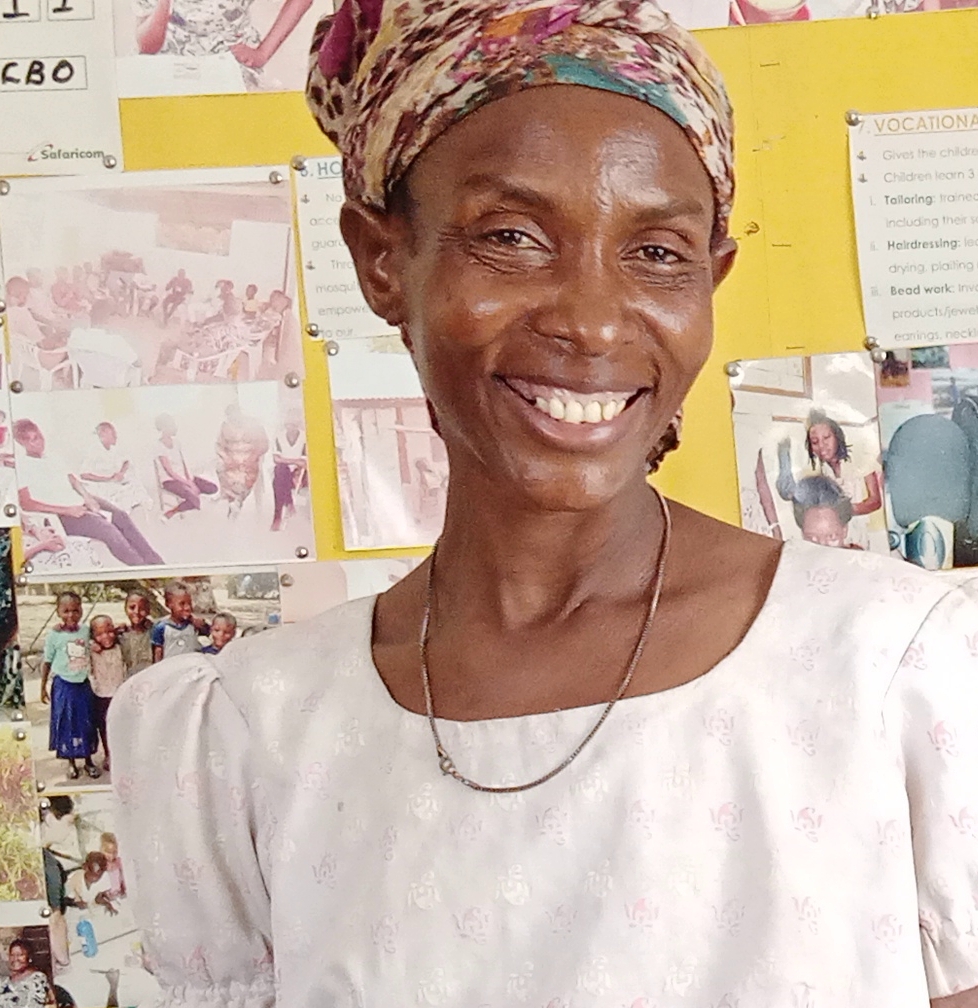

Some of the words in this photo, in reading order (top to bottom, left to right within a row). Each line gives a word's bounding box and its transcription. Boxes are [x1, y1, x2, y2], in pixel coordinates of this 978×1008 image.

[41, 148, 104, 160] Safaricom
[883, 150, 914, 161] Gives
[918, 149, 936, 159] the
[884, 171, 932, 183] Children
[935, 171, 964, 181] learn
[968, 169, 975, 179] 3
[886, 215, 939, 228] including
[942, 215, 967, 226] their
[887, 238, 961, 251] Hairdressing:
[931, 260, 974, 273] plaiting
[890, 284, 920, 296] Bead
